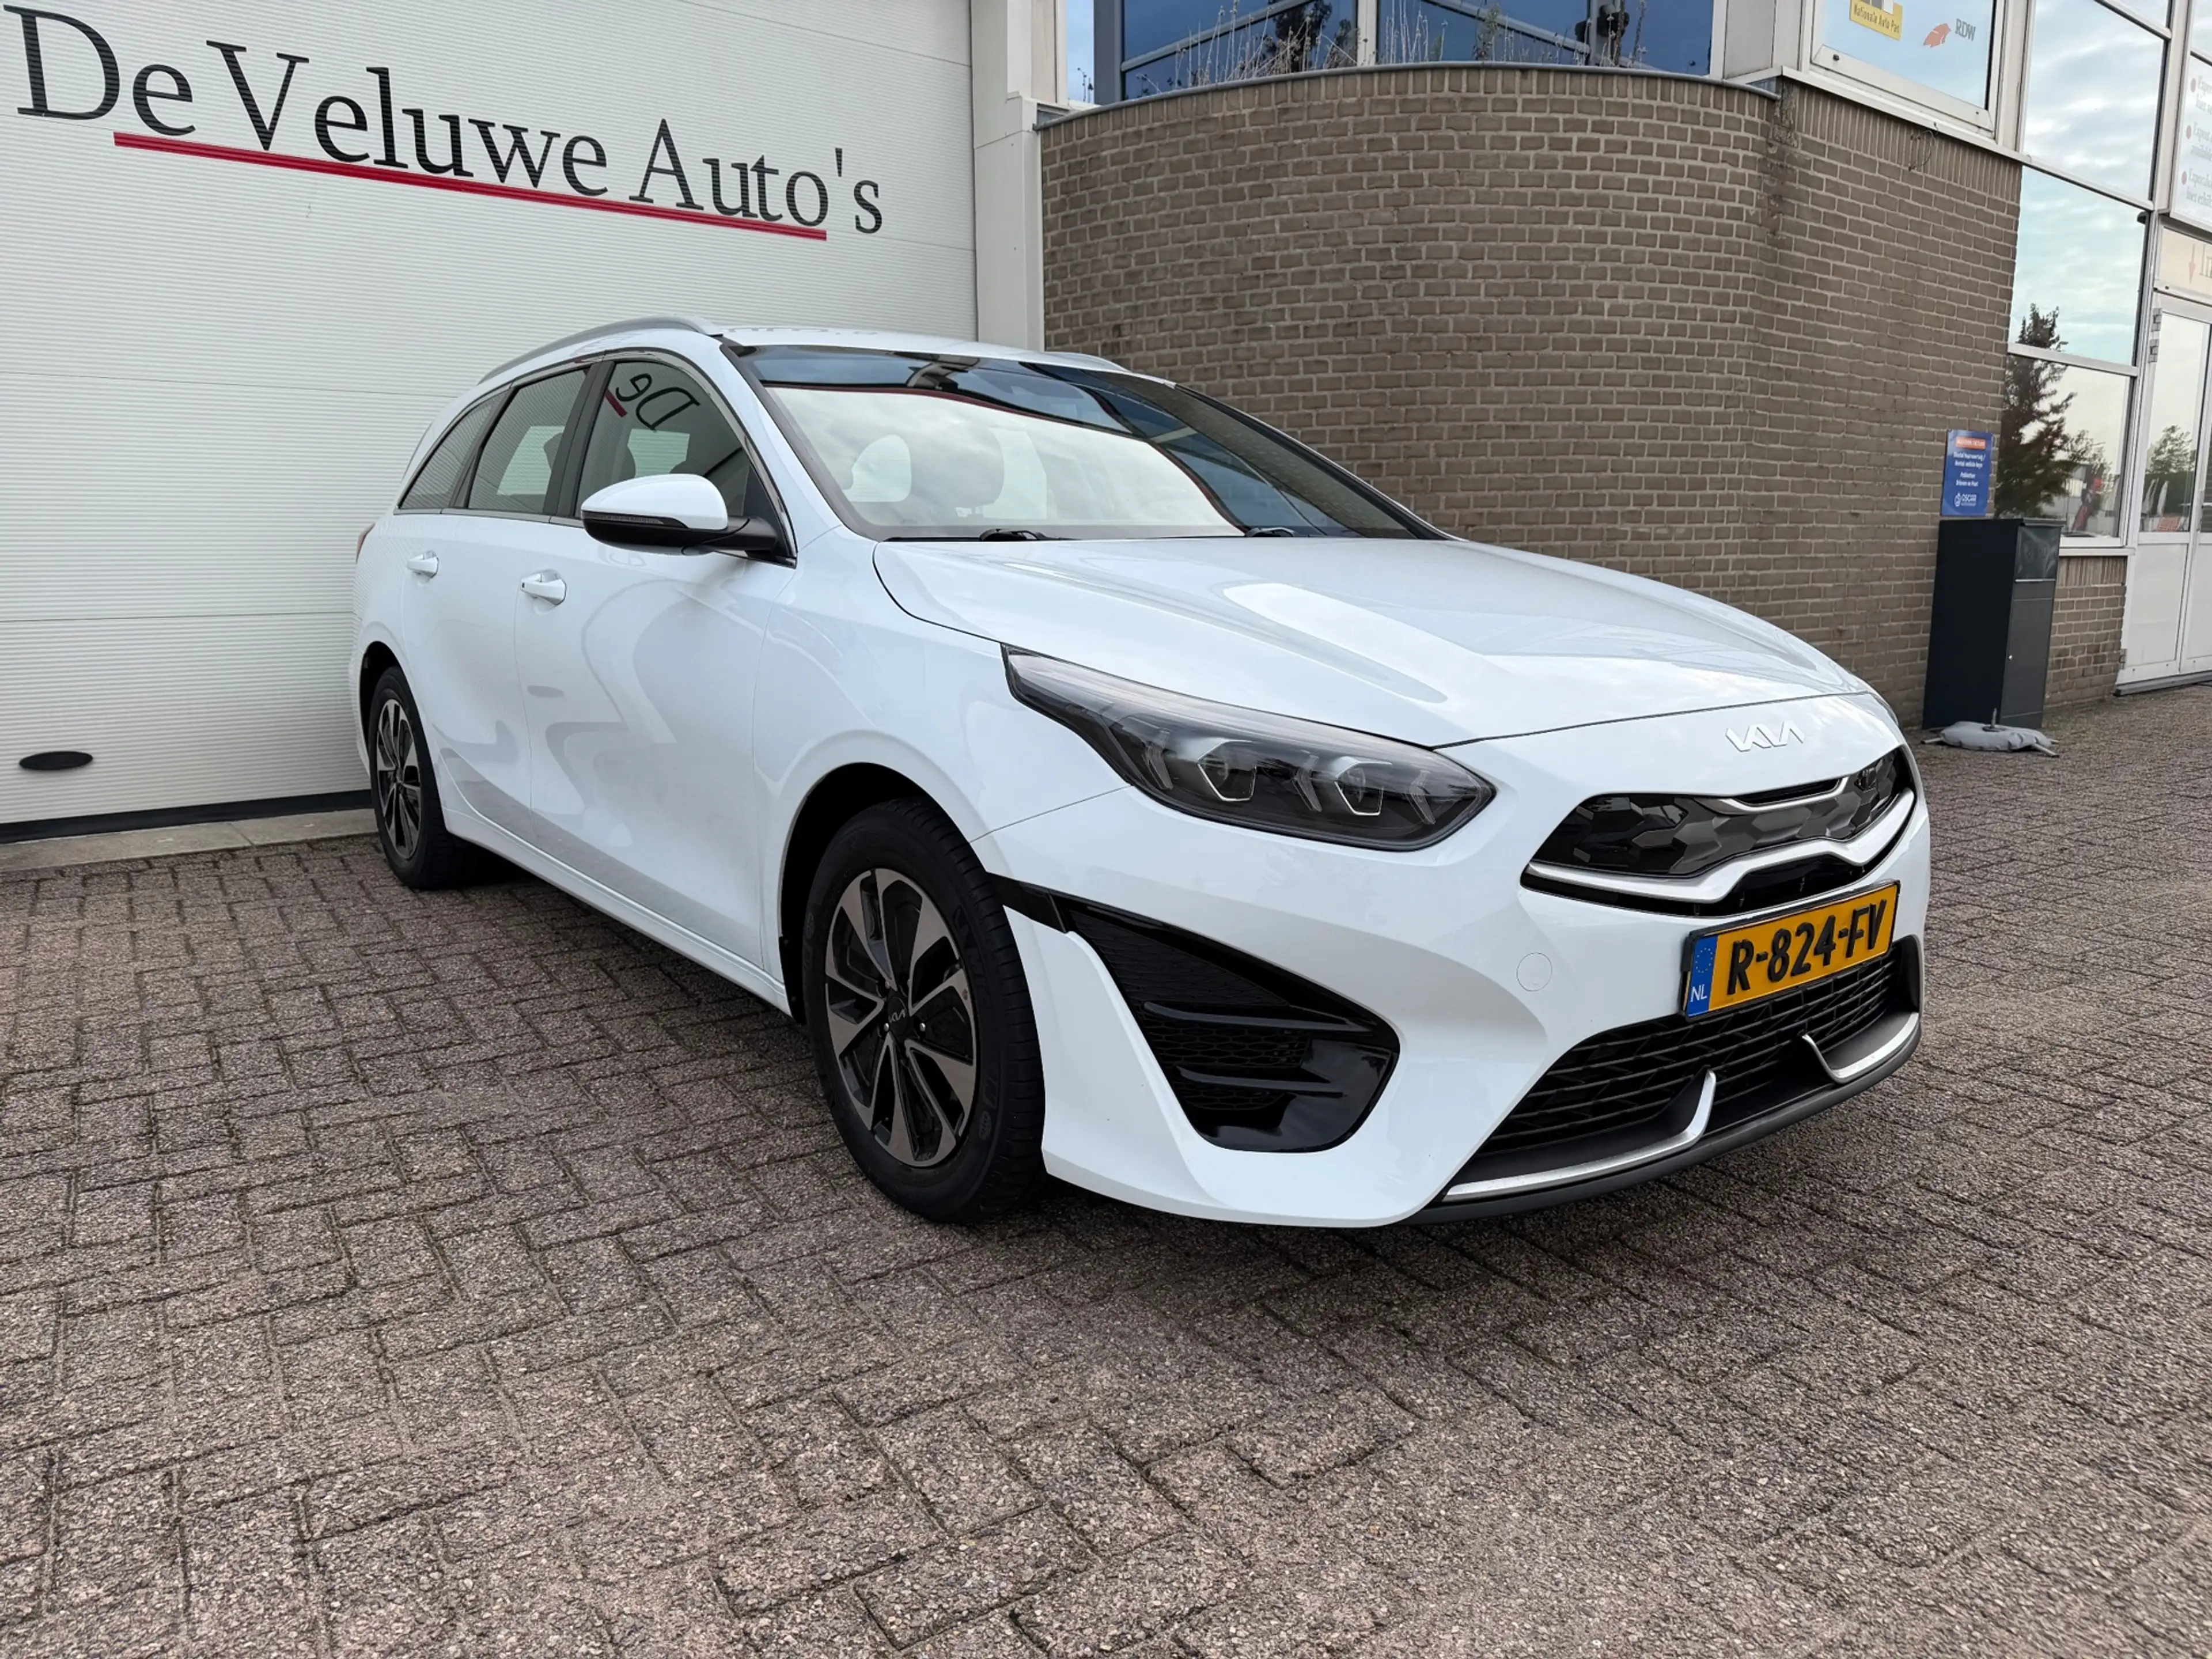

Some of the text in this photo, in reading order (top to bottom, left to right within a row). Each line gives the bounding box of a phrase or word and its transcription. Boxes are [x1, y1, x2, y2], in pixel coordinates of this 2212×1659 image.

[1878, 14, 1890, 29] Auto
[1955, 18, 1976, 41] RDW
[3, 4, 882, 234] De Veluwe Auto's
[1727, 899, 1887, 995] R-824-FV
[1690, 984, 1707, 1003] NL
